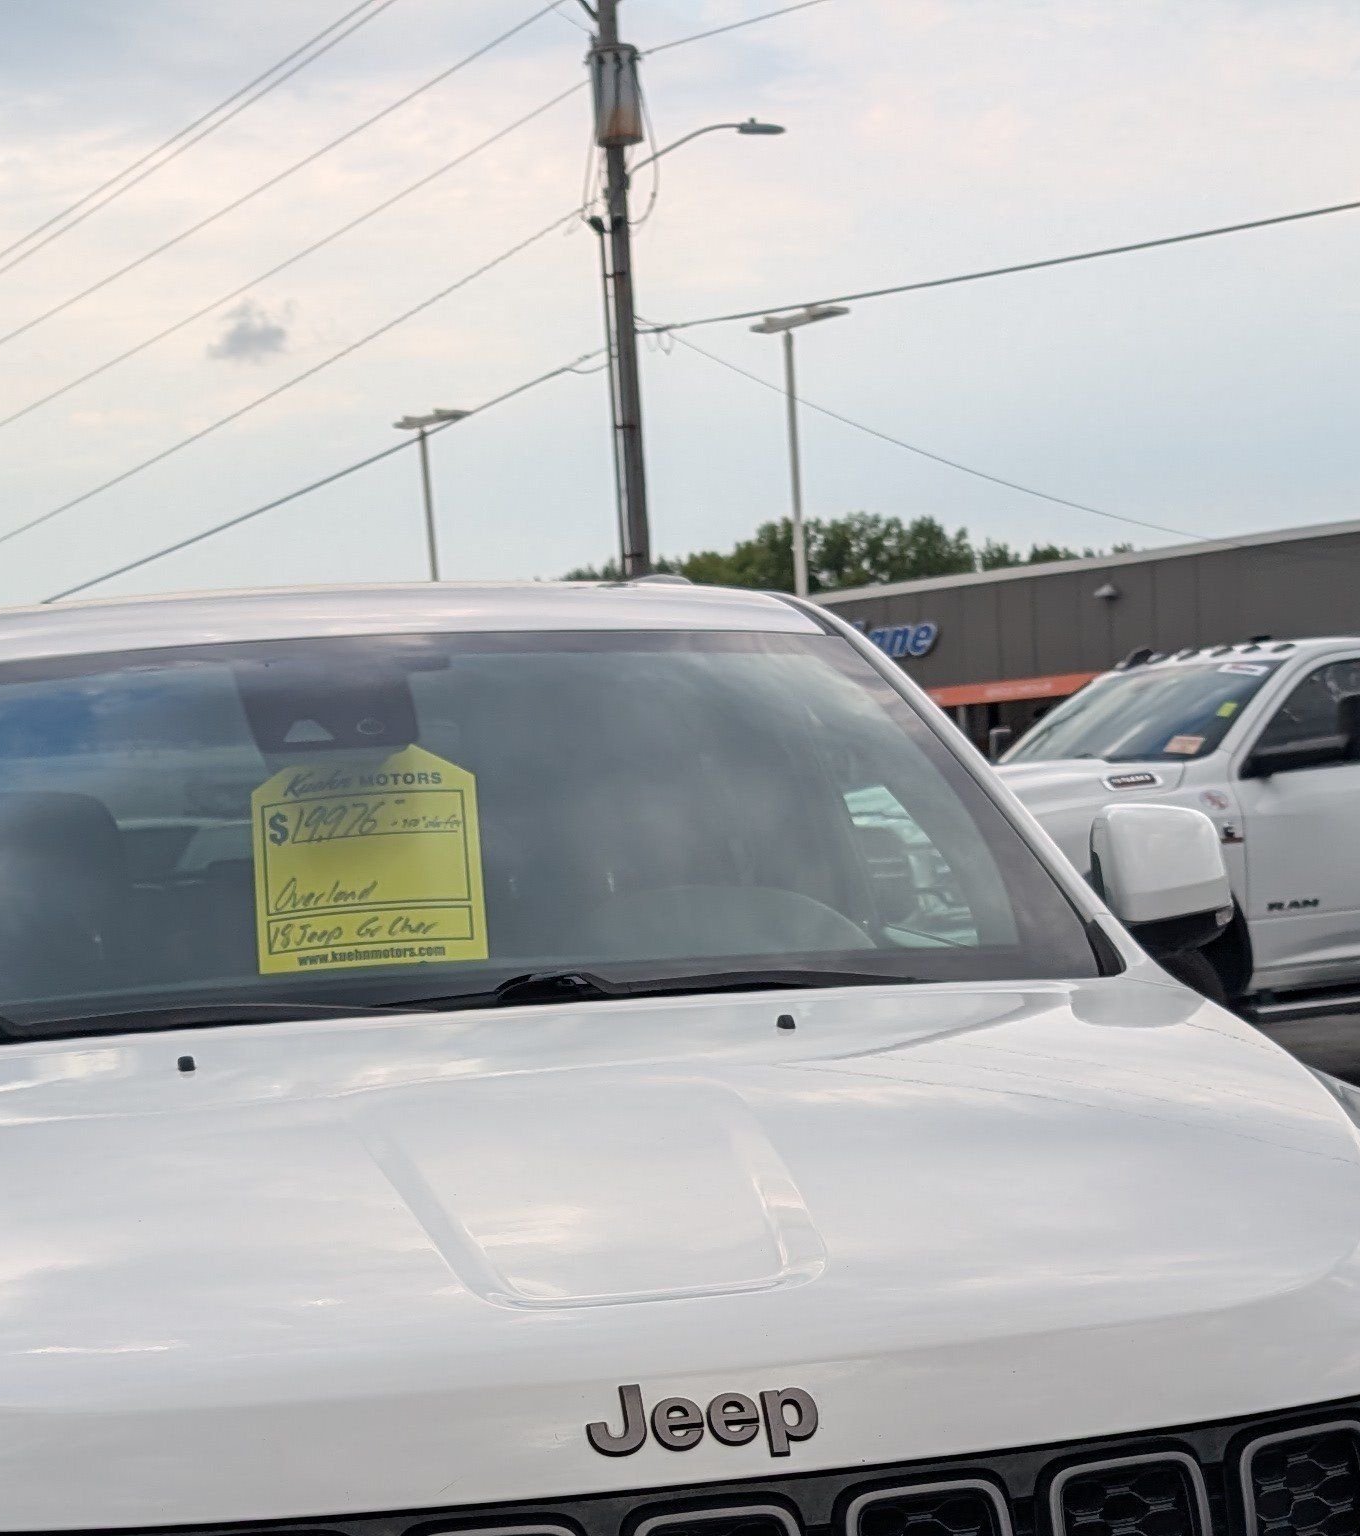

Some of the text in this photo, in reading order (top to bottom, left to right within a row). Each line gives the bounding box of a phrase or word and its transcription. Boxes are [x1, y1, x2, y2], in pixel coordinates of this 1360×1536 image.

[358, 770, 442, 787] MOTORS
[1267, 898, 1320, 911] RAM
[295, 923, 344, 946] Jeep
[297, 944, 446, 967] www.kuehnmotors.com
[586, 1384, 819, 1458] Jeep
